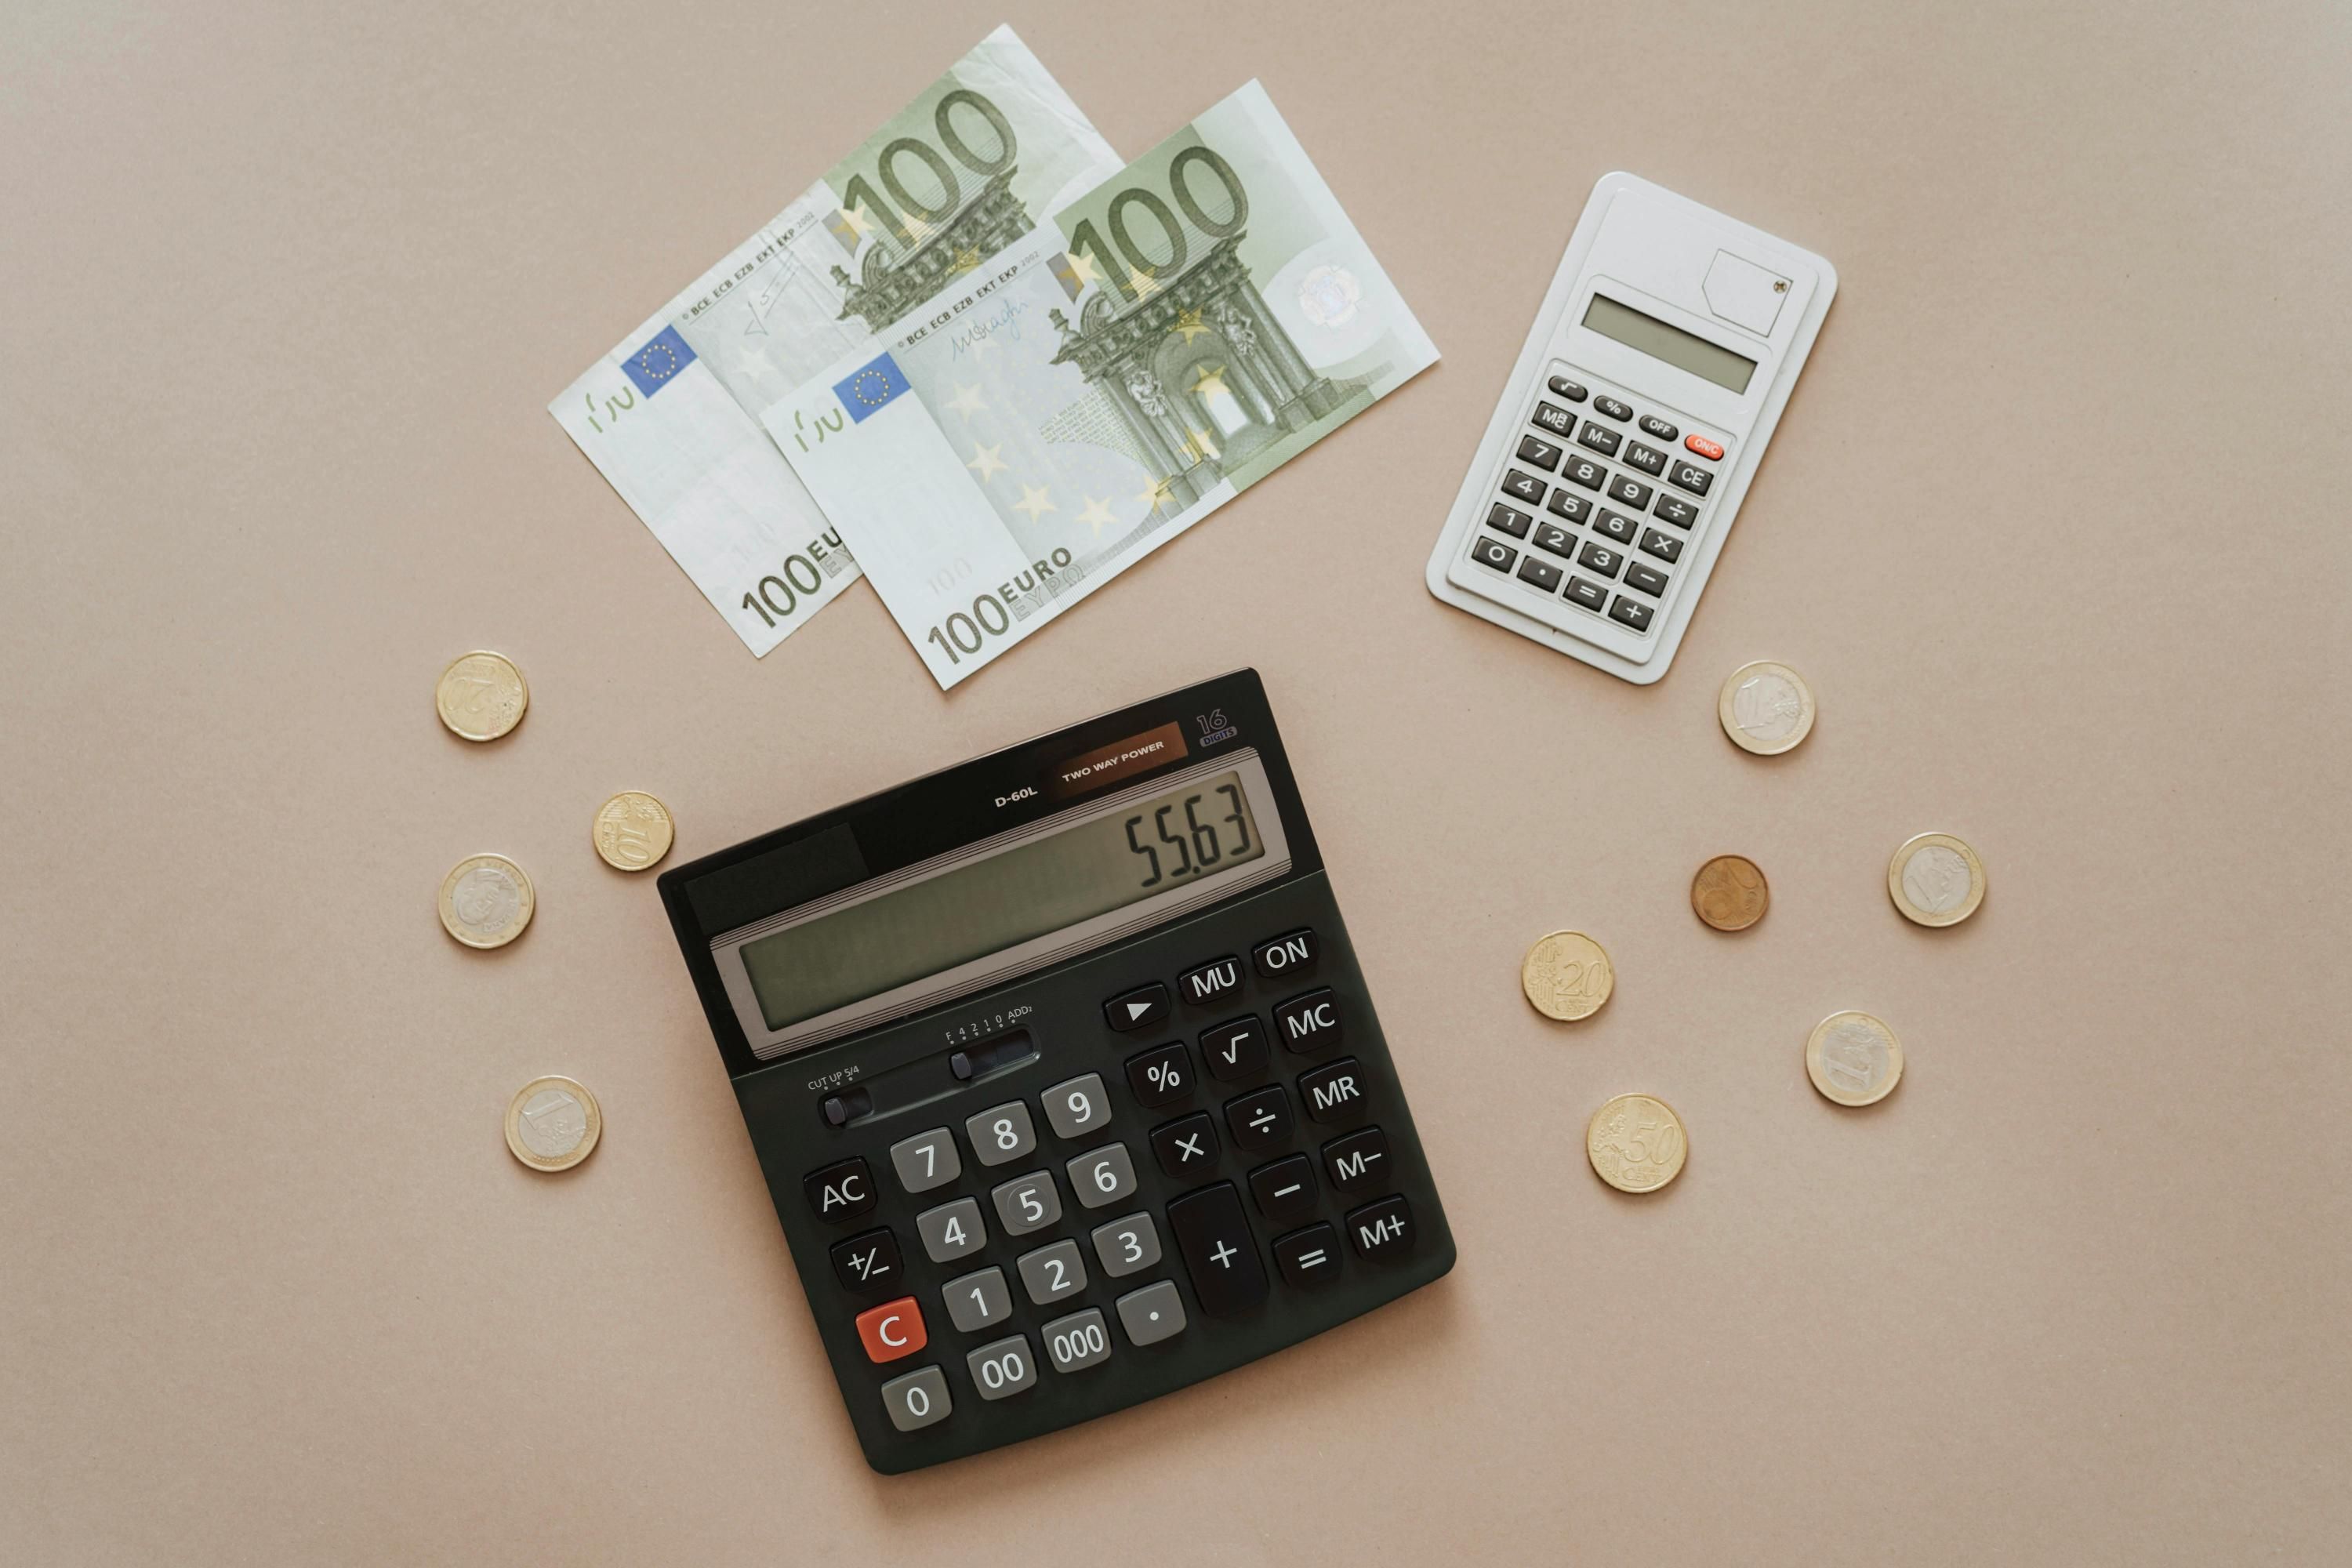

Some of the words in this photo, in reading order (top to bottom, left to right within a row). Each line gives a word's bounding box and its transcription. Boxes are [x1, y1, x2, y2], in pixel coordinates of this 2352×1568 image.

[844, 89, 1017, 250] 100
[1069, 146, 1249, 303] 100
[691, 299, 712, 316] BCE
[713, 280, 733, 298] ECB
[734, 263, 754, 281] EZB
[756, 245, 776, 263] EKT
[776, 228, 796, 247] EKP
[906, 328, 928, 345] BCE
[930, 312, 951, 329] ECB
[953, 296, 974, 314] EZB
[976, 281, 996, 298] EKT
[999, 266, 1018, 283] EKP
[1649, 420, 1670, 434] OFF
[1536, 445, 1549, 459] 7
[1634, 448, 1657, 465] M+
[1694, 438, 1719, 454] ON/C
[1517, 479, 1533, 493] 4
[1577, 463, 1593, 480] 8
[1681, 469, 1704, 485] CE
[1563, 499, 1577, 513] 5
[1624, 484, 1639, 499] 9
[1505, 513, 1514, 525] 1
[1609, 517, 1624, 532] 6
[1548, 532, 1564, 547] 2
[1594, 551, 1610, 566] 3
[742, 554, 822, 628] 100
[928, 594, 1010, 664] 100
[997, 548, 1072, 604] EURO
[1196, 709, 1229, 734] 16
[1203, 728, 1236, 746] DIGITS
[1062, 767, 1091, 783] TWO
[1093, 757, 1119, 771] WAY
[1120, 740, 1165, 761] POWER
[994, 786, 1038, 808] D-60L
[616, 822, 651, 863] 10
[1125, 783, 1251, 887] 55.63
[1266, 937, 1308, 969] ON
[1191, 963, 1236, 997] MU
[1555, 960, 1606, 997] 20
[971, 1023, 978, 1032] 2
[996, 1014, 1002, 1023] 0
[1287, 1003, 1335, 1039] MC
[808, 1076, 828, 1091] CUT
[829, 1071, 843, 1083] UP
[844, 1065, 859, 1077] 5/4
[1312, 1076, 1360, 1109] MR
[1068, 1092, 1092, 1123] 9
[993, 1119, 1018, 1150] 8
[1624, 1122, 1676, 1165] 50
[916, 1145, 935, 1178] 7
[1094, 1161, 1117, 1192] 6
[822, 1175, 866, 1213] AC
[1019, 1189, 1044, 1221] 5
[943, 1217, 967, 1246] 4
[1118, 1232, 1142, 1262] 3
[1359, 1214, 1405, 1249] M+
[1044, 1259, 1071, 1291] 2
[970, 1288, 989, 1316] 1
[879, 1316, 908, 1347] C
[1054, 1324, 1104, 1363] 000
[982, 1353, 1024, 1388] 00
[906, 1387, 930, 1417] 0
